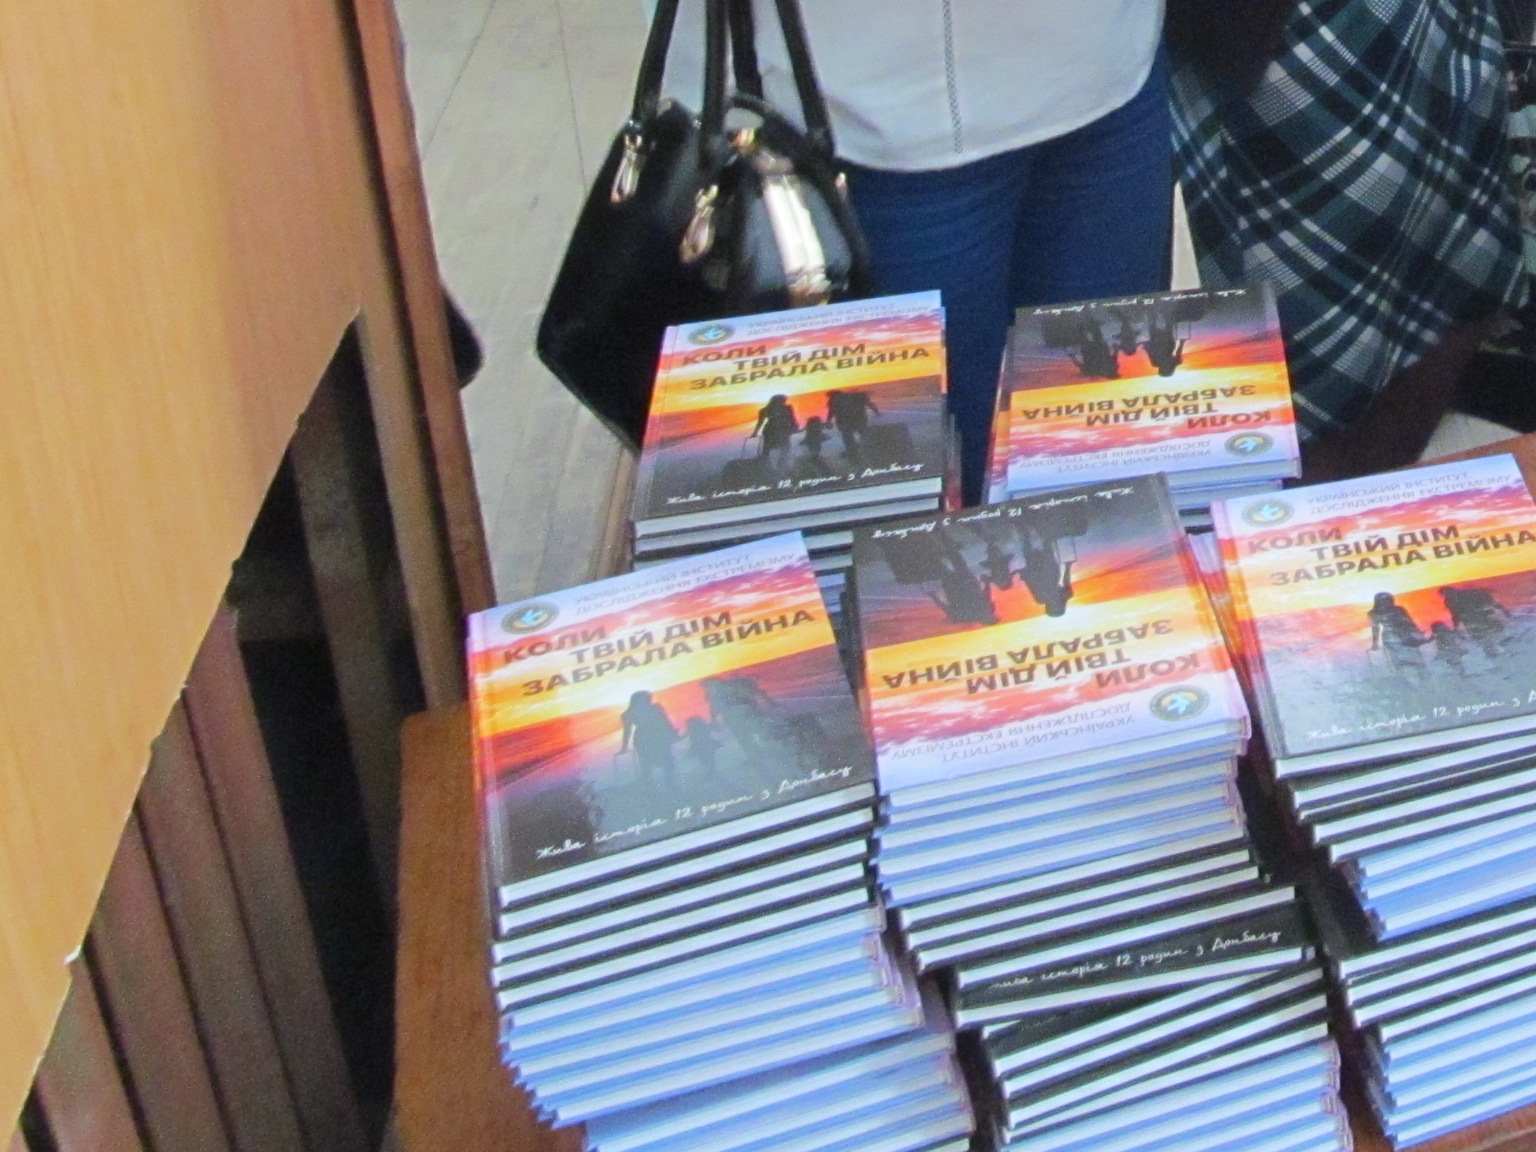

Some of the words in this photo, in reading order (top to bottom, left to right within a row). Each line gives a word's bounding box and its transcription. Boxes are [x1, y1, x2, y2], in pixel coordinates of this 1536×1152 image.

[682, 345, 766, 366] КОЛИ
[690, 362, 828, 390] ЗАБРАЛА
[837, 347, 931, 370] ВІЙНА
[735, 351, 801, 371] ТВІЙ
[808, 343, 865, 361] ДІМ
[1022, 399, 1114, 420] ВІЙНА
[1123, 385, 1256, 408] ЗАБРАЛА
[1151, 402, 1218, 421] ТВІЙ
[1087, 408, 1141, 427] ДІМ
[1187, 410, 1271, 429] КОЛИ
[1306, 484, 1400, 505] УКРАЇНСЬКИЙ
[1405, 472, 1469, 489] ІНСТИТУТ
[1310, 491, 1415, 515] ДОСЛІДЖЕННЯ
[1419, 474, 1511, 496] ЕКСТРЕМІЗМУ
[1247, 526, 1342, 554] КОЛИ
[1310, 534, 1388, 562] ТВІЙ
[1396, 525, 1460, 549] ДІМ
[1270, 546, 1429, 586] ЗАБРАЛА
[503, 624, 607, 663] КОЛИ
[522, 640, 695, 697] ЗАБРАЛА
[700, 609, 816, 650] ВІЙНА
[570, 630, 654, 664] ТВІЙ
[662, 611, 732, 643] ДІМ
[1006, 618, 1174, 663] ЗАБРАЛА
[882, 652, 998, 689] ВІЙНА
[966, 662, 1037, 695] ДІМ
[1048, 647, 1131, 682] ТВІЙ
[1096, 652, 1201, 689] КОЛИ
[1009, 701, 1131, 736] ДОСЛІДЖЕННЯ
[1023, 715, 1136, 747] УКРАЇНСЬКИЙ
[1306, 725, 1351, 741] Жива
[1360, 714, 1426, 732] історія
[1456, 700, 1505, 717] родин
[891, 730, 1003, 760] ЕКСТРЕМІЗМУ
[942, 738, 1019, 762] ІНСТИТУТ
[1041, 961, 1108, 982] історія
[1115, 952, 1133, 967] 12
[1140, 947, 1188, 966] родин
[1212, 929, 1282, 951] Донбасу
